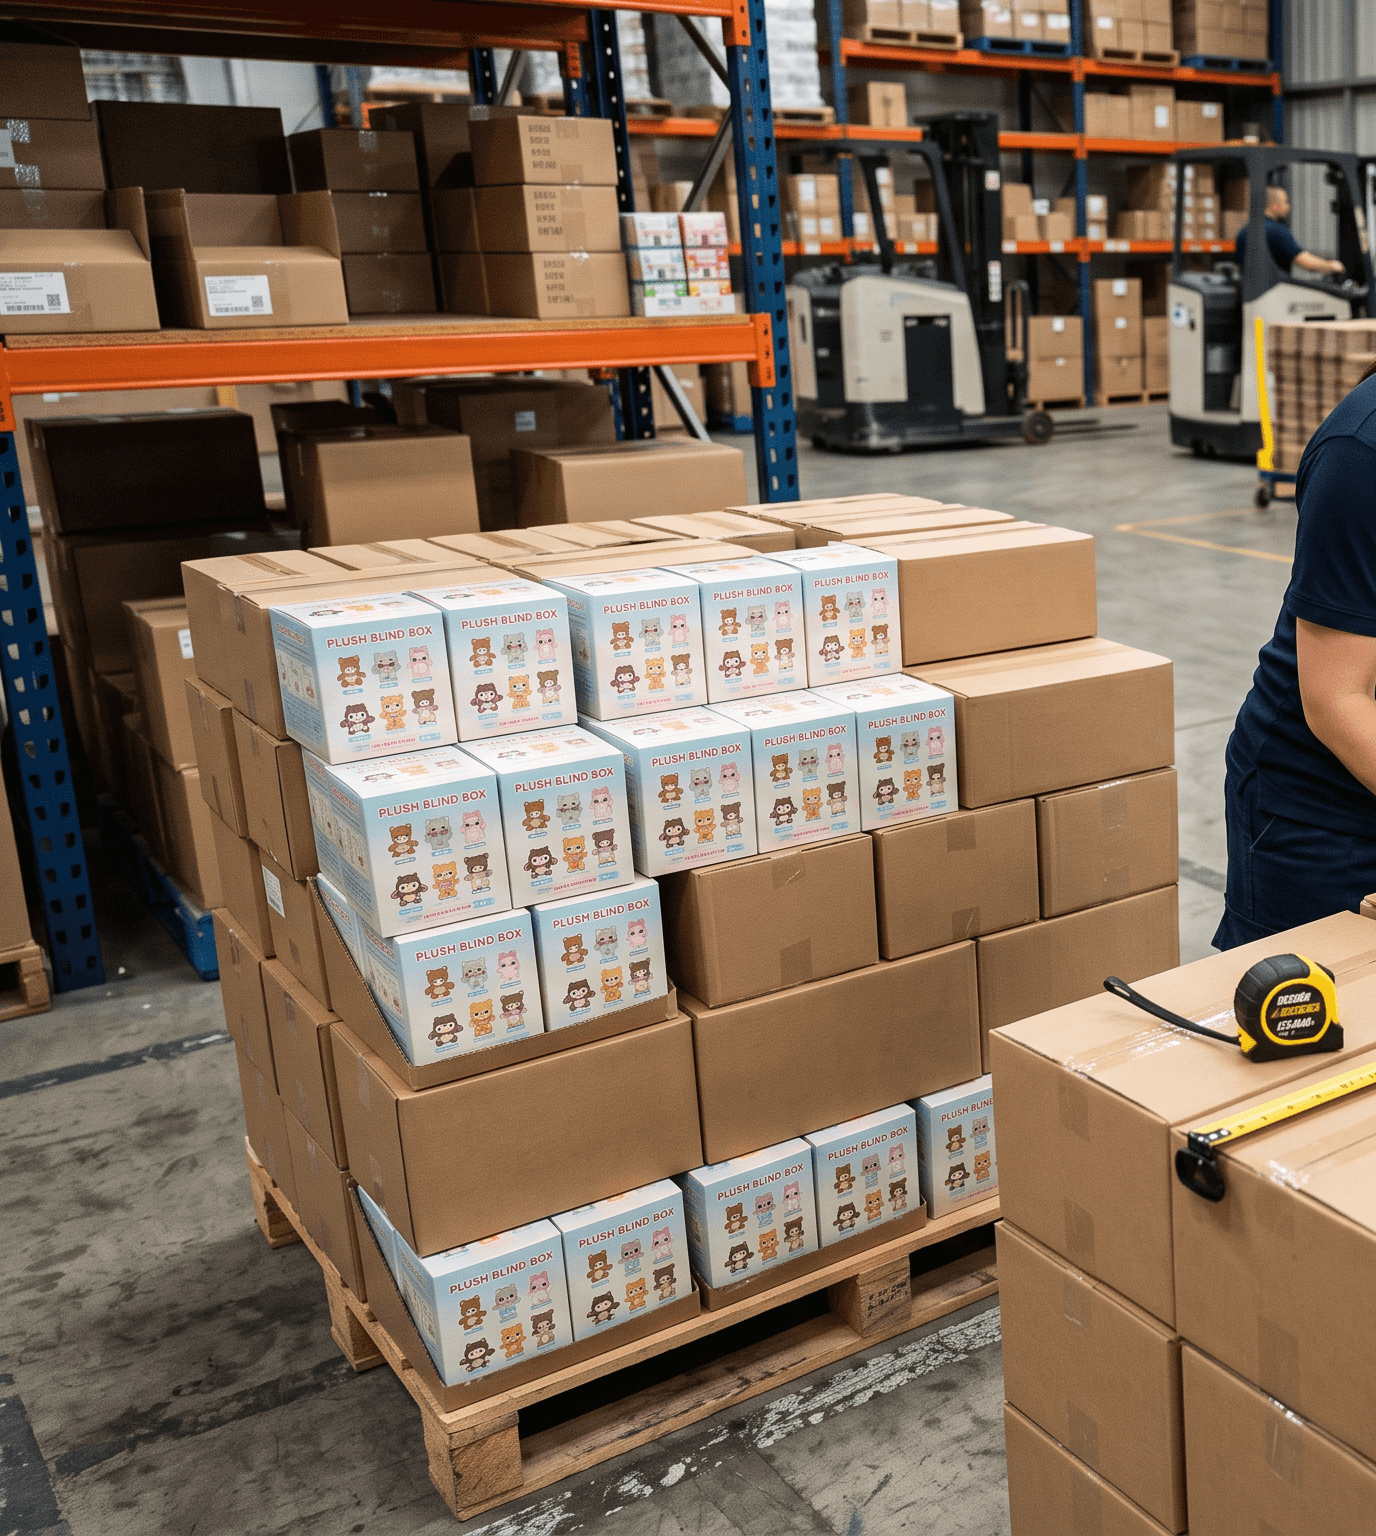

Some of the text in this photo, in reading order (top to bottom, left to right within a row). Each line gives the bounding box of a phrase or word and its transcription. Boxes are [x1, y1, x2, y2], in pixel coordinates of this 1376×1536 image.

[846, 573, 870, 584] BLIND
[872, 571, 889, 581] BOX
[714, 583, 793, 601] PLUSH BLIND BOX
[604, 596, 690, 615] PLUSH BLIND BOX
[462, 610, 558, 629] PLUSH BLIND BOX
[327, 626, 433, 649] PLUSH BLIND BOX
[868, 709, 947, 729] PLUSH BLIND BOX
[765, 734, 796, 747] PLUSH
[798, 728, 827, 741] BLIND
[652, 744, 742, 767] PLUSH BLIND BOX
[515, 767, 614, 793] PLUSH BLIND BOX
[423, 794, 459, 810] BLIND
[462, 790, 487, 802] BOX
[593, 904, 625, 920] BLIND
[627, 899, 649, 912] BOX
[416, 929, 522, 962] PLUSH BLIND BOX
[942, 1106, 969, 1122] PLUSH
[828, 1127, 909, 1161] PLUSH BLIND BOX
[718, 1163, 804, 1202] PLUSH BLIND BOX
[579, 1208, 675, 1248] PLUSH BLIND BOX
[450, 1251, 554, 1294] PLUSH BLIND BOX
